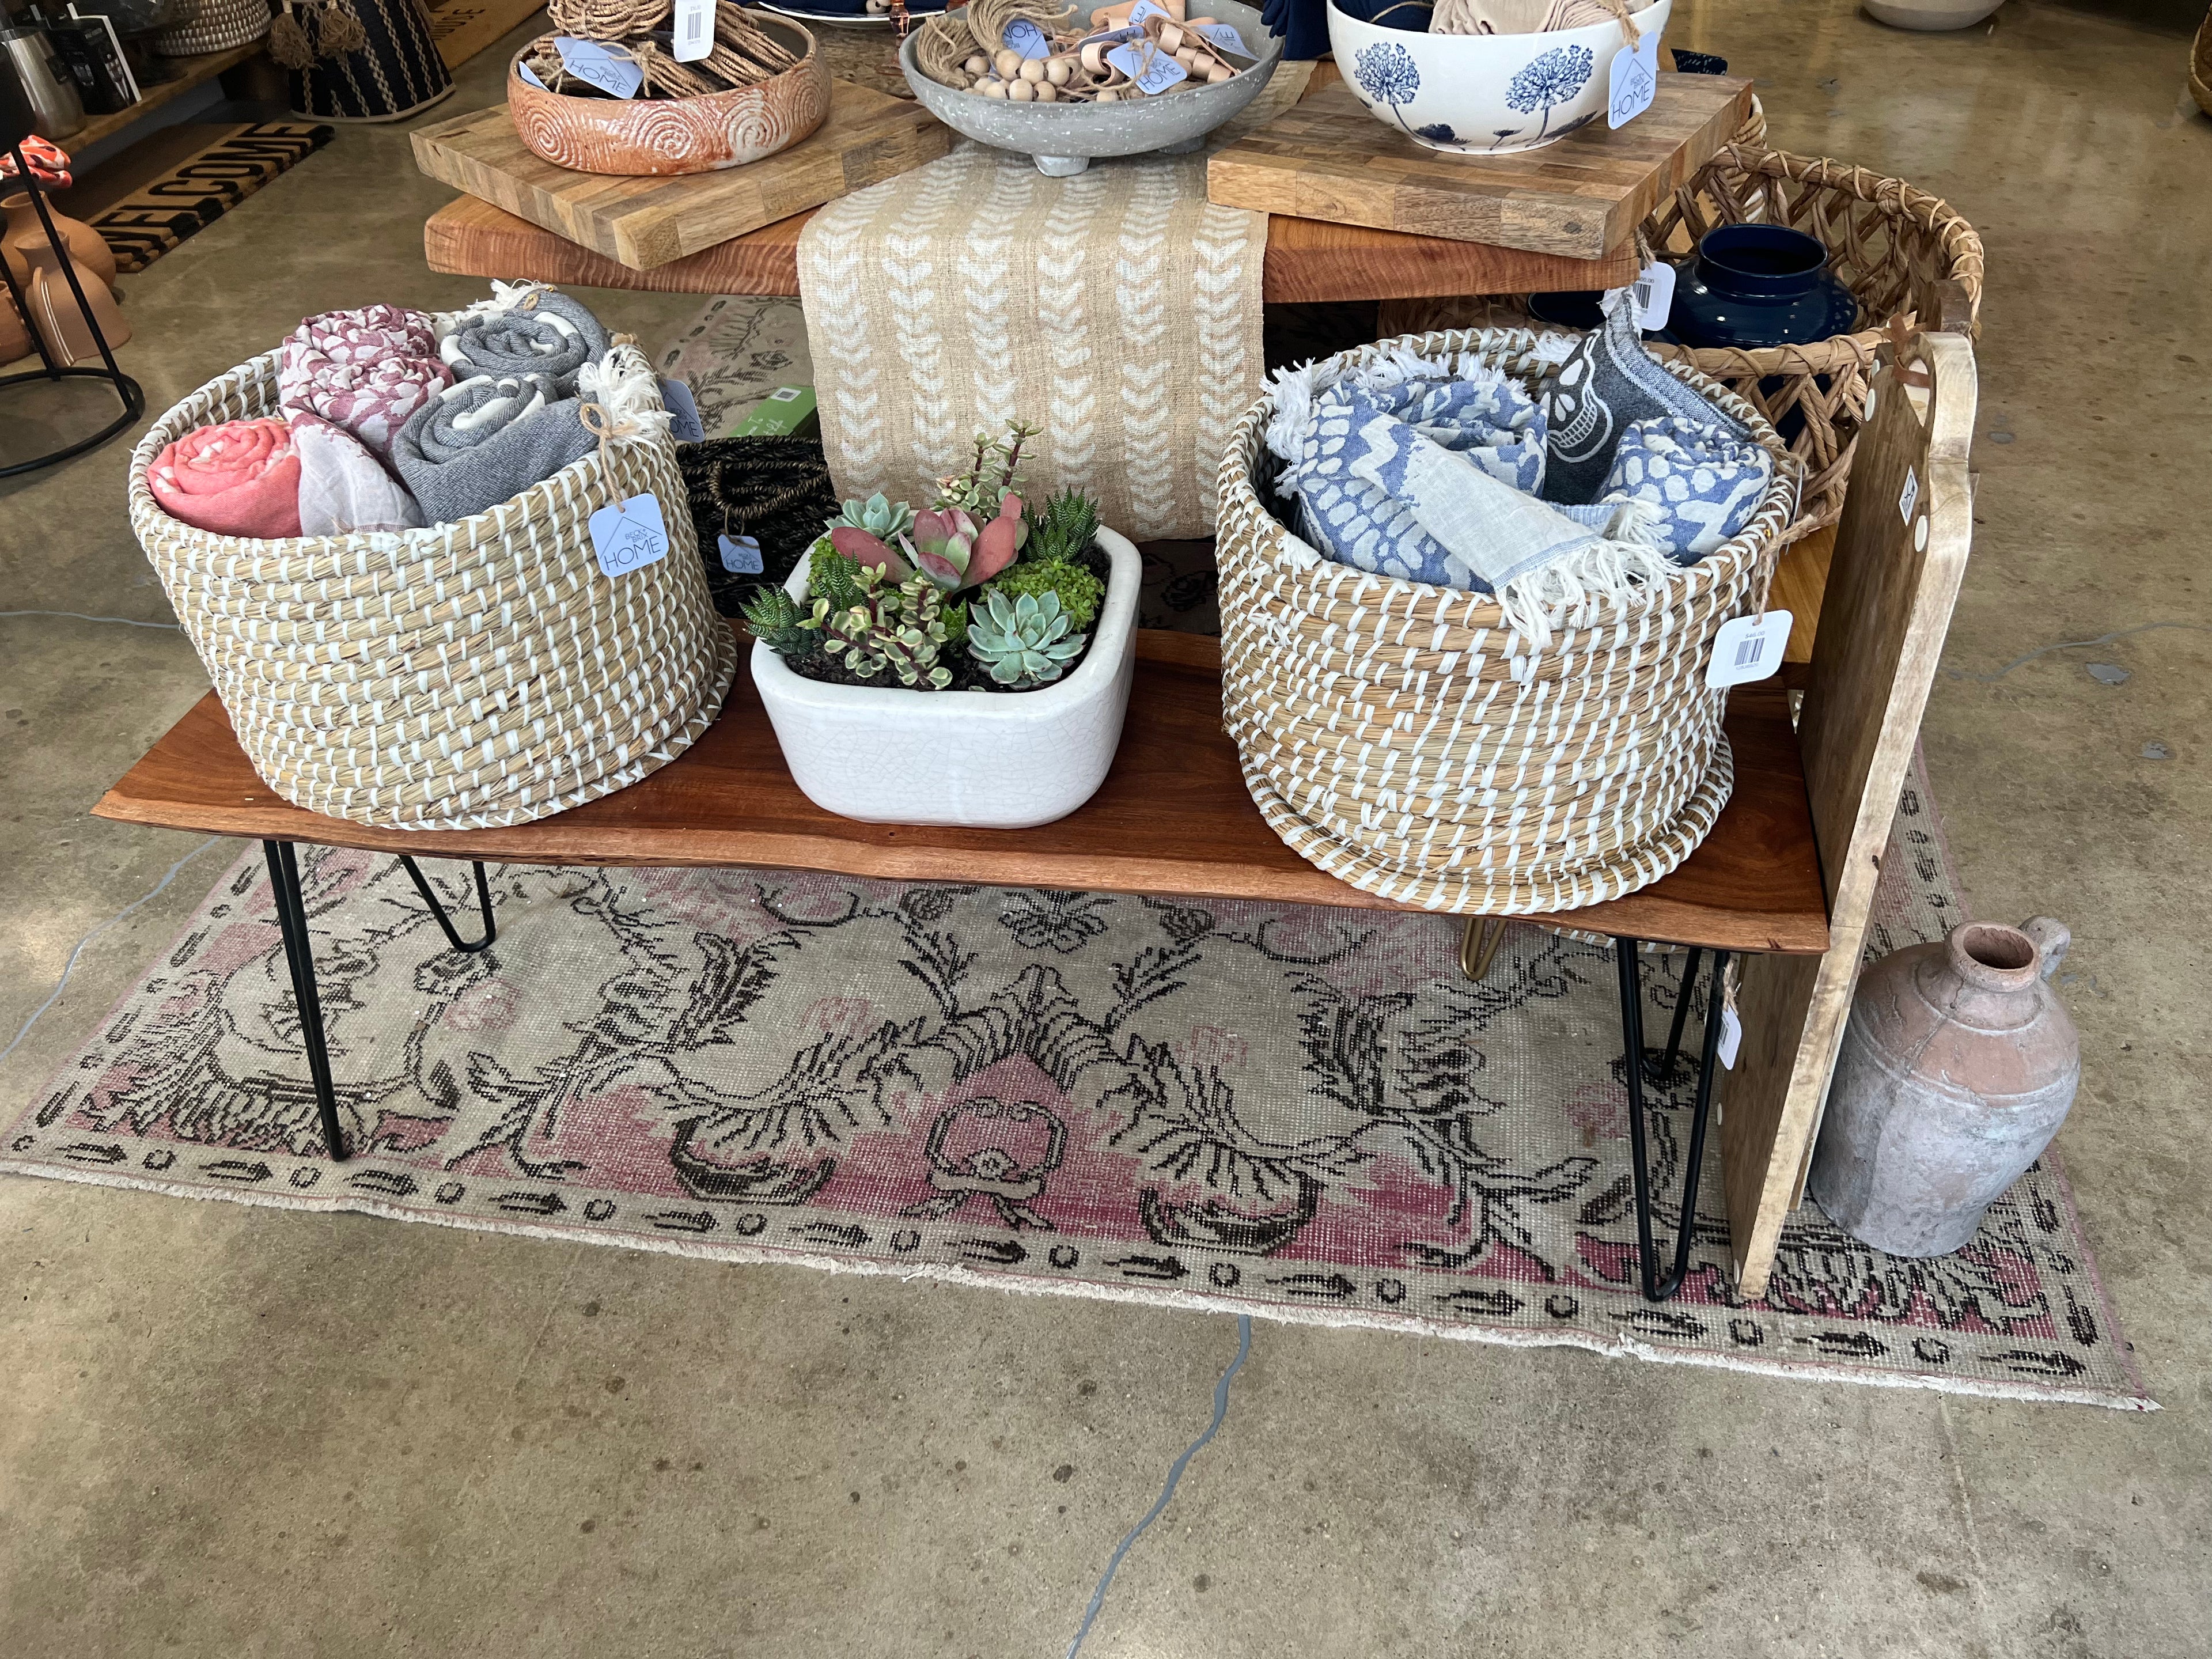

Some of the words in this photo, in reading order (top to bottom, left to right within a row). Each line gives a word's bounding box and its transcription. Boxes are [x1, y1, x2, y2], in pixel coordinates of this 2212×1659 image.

[569, 60, 627, 94] HOME
[1139, 63, 1180, 90] HOME
[1612, 80, 1650, 123] HOME
[669, 418, 699, 438] OME
[604, 536, 661, 571] HOME
[726, 559, 760, 571] HOME
